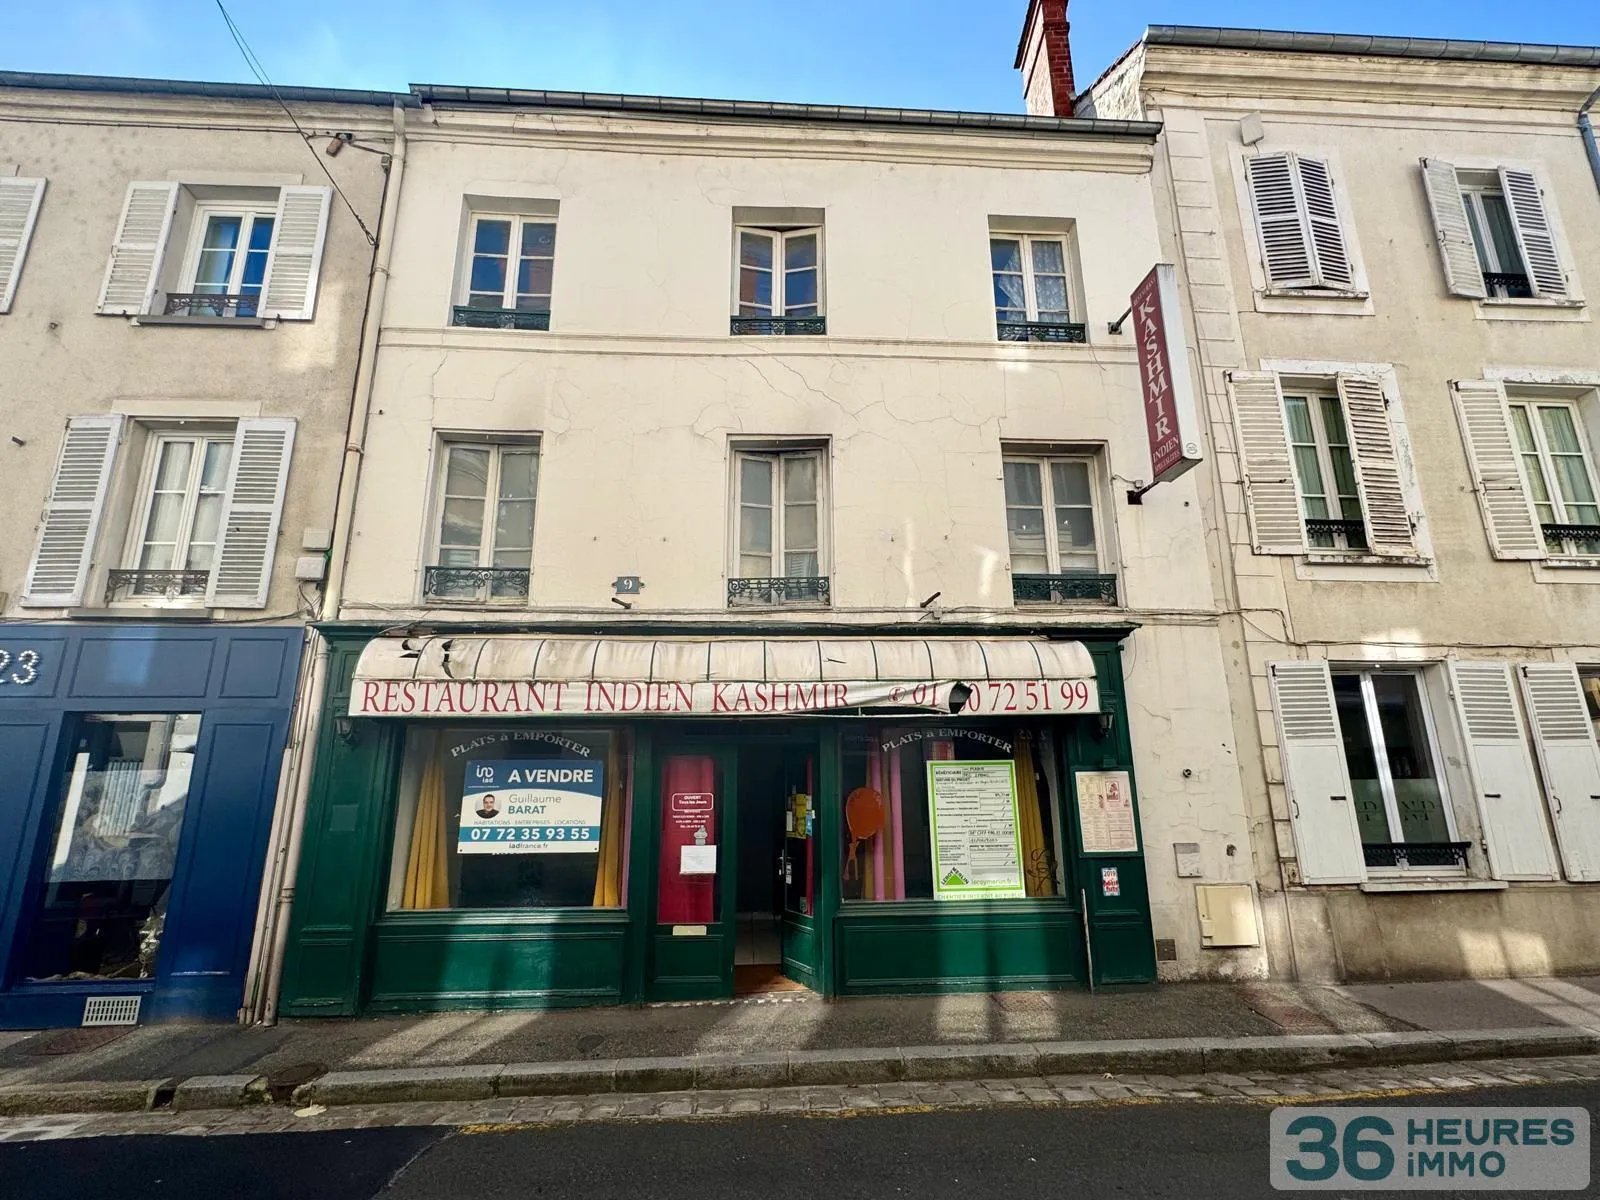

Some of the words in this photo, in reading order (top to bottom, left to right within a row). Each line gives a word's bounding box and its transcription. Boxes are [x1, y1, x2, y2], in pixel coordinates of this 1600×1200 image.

[1138, 292, 1172, 442] KASHMIR
[1152, 434, 1179, 463] INDIEN
[623, 578, 633, 590] 9
[361, 681, 570, 714] RESTAURANT
[584, 682, 694, 713] INDIEN
[711, 682, 849, 713] KASHMIR
[912, 682, 938, 708] 01
[961, 682, 982, 713] 0
[988, 682, 1018, 713] 72
[1025, 681, 1053, 712] 51
[1060, 681, 1089, 712] 99
[451, 733, 496, 758] PLATS
[513, 731, 592, 759] EMPORTER
[881, 730, 923, 753] PLATS
[938, 728, 1013, 754] EMPORTER
[508, 769, 521, 783] A
[524, 769, 593, 783] VENDRE
[508, 794, 562, 804] Guillaume
[508, 805, 547, 814] BARAT
[471, 828, 490, 840] 07
[496, 828, 515, 840] 72
[521, 828, 540, 840] 35
[546, 828, 565, 840] 93
[570, 828, 590, 840] 55
